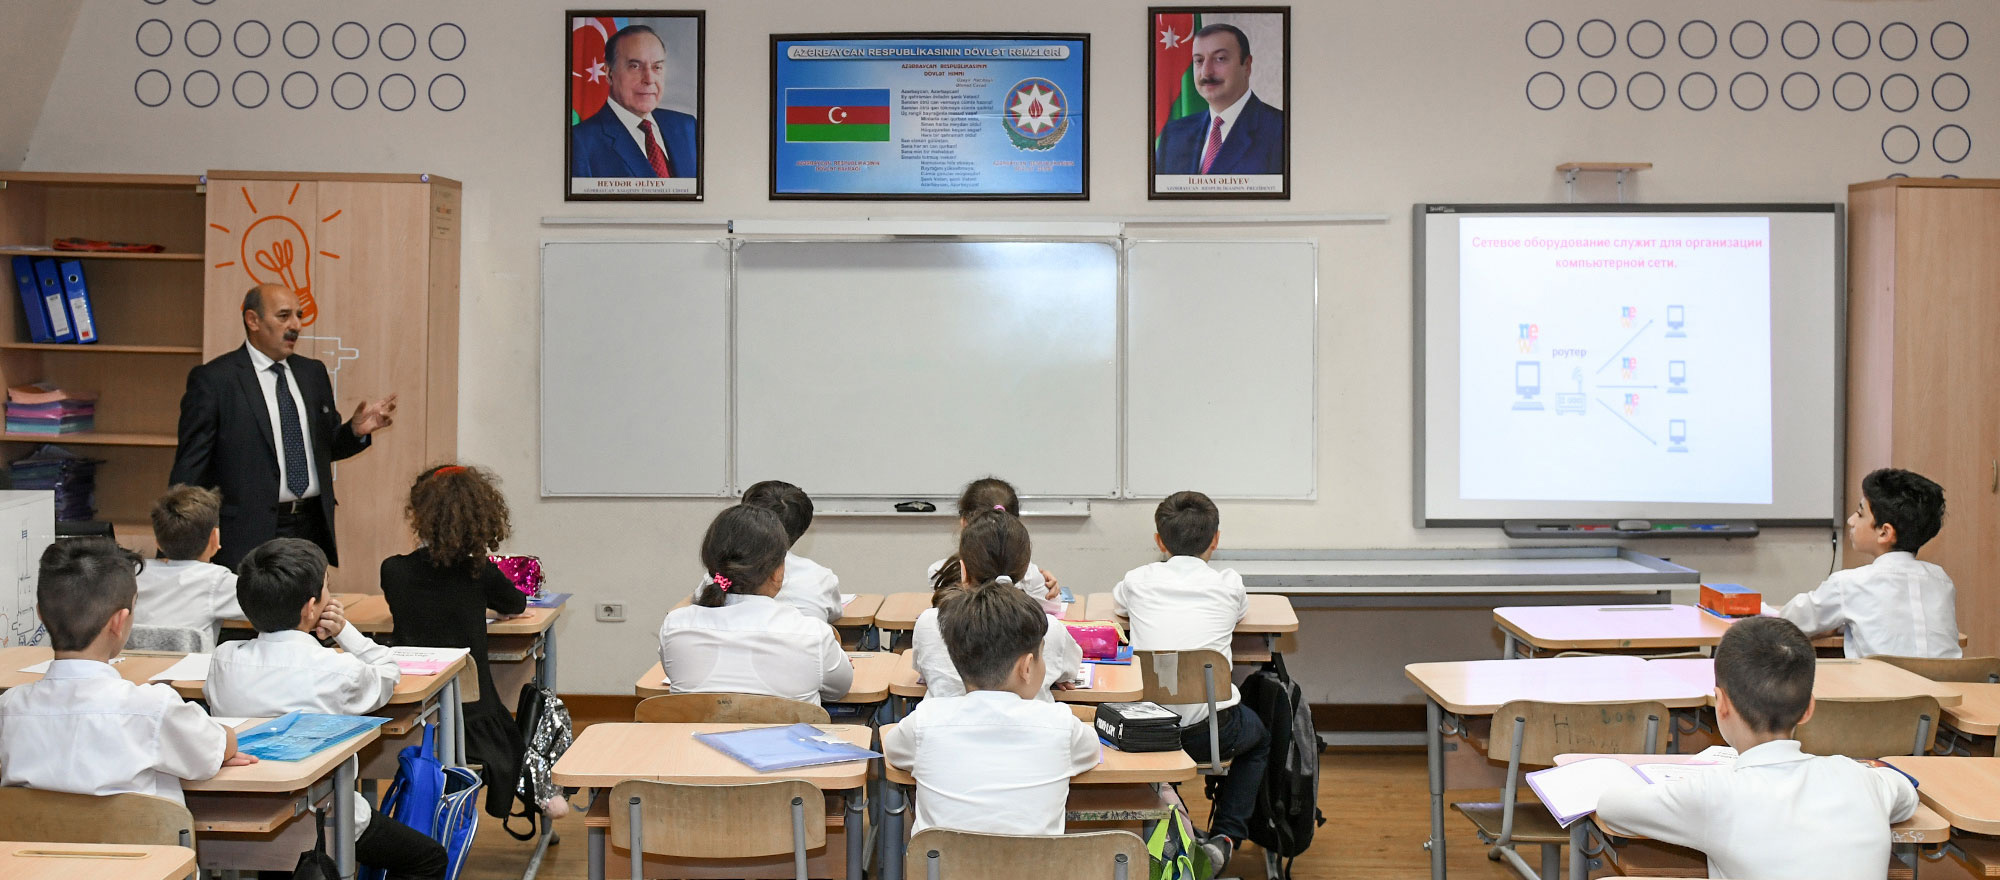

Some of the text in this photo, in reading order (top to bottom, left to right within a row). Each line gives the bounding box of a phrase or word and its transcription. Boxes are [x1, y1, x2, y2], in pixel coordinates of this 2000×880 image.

[794, 47, 1061, 57] AZƏRBAYCAN RESPUBLİKASININ DÖVLƏT RƏMZLƏRİ
[635, 179, 666, 187] ƏLİYEV
[1188, 177, 1250, 185] İLHAM ƏLİYEV
[1472, 236, 1762, 250] Сетевое оборудование служит для организации
[1555, 257, 1678, 270] компьютерной сети.
[1552, 347, 1587, 359] роутер
